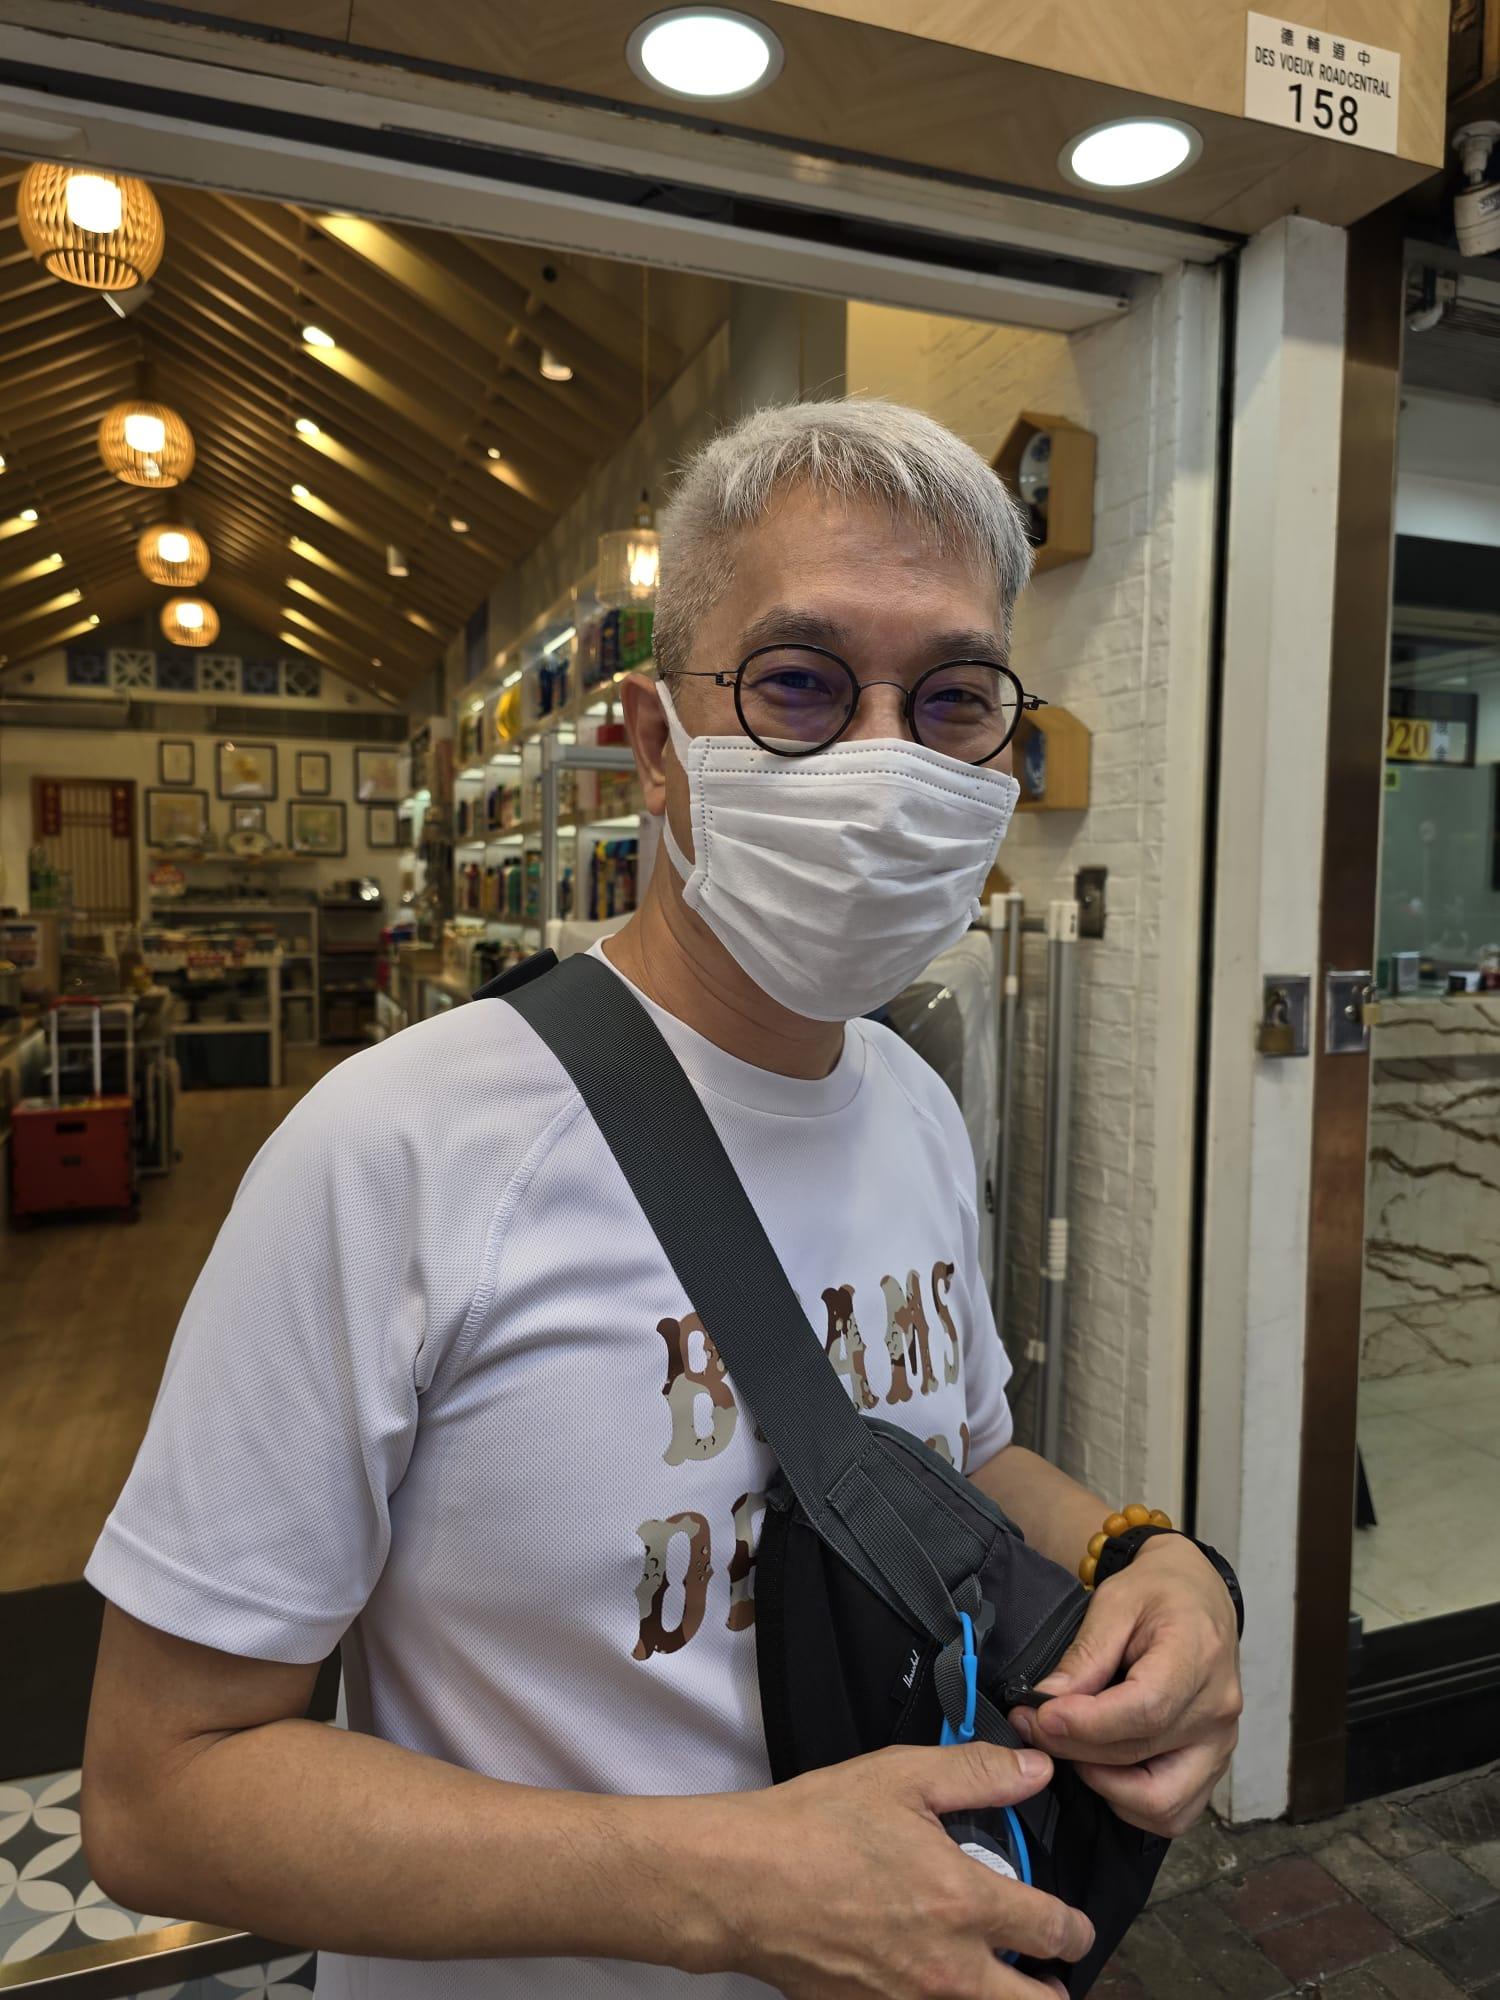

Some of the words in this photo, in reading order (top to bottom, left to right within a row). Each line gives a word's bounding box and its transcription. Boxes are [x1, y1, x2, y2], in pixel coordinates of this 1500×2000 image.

[1255, 46, 1275, 67] DES
[1280, 52, 1314, 78] VOEUX
[1281, 27, 1371, 66] 德輔道中
[1288, 84, 1358, 136] 158
[656, 1261, 960, 1466] BAMS
